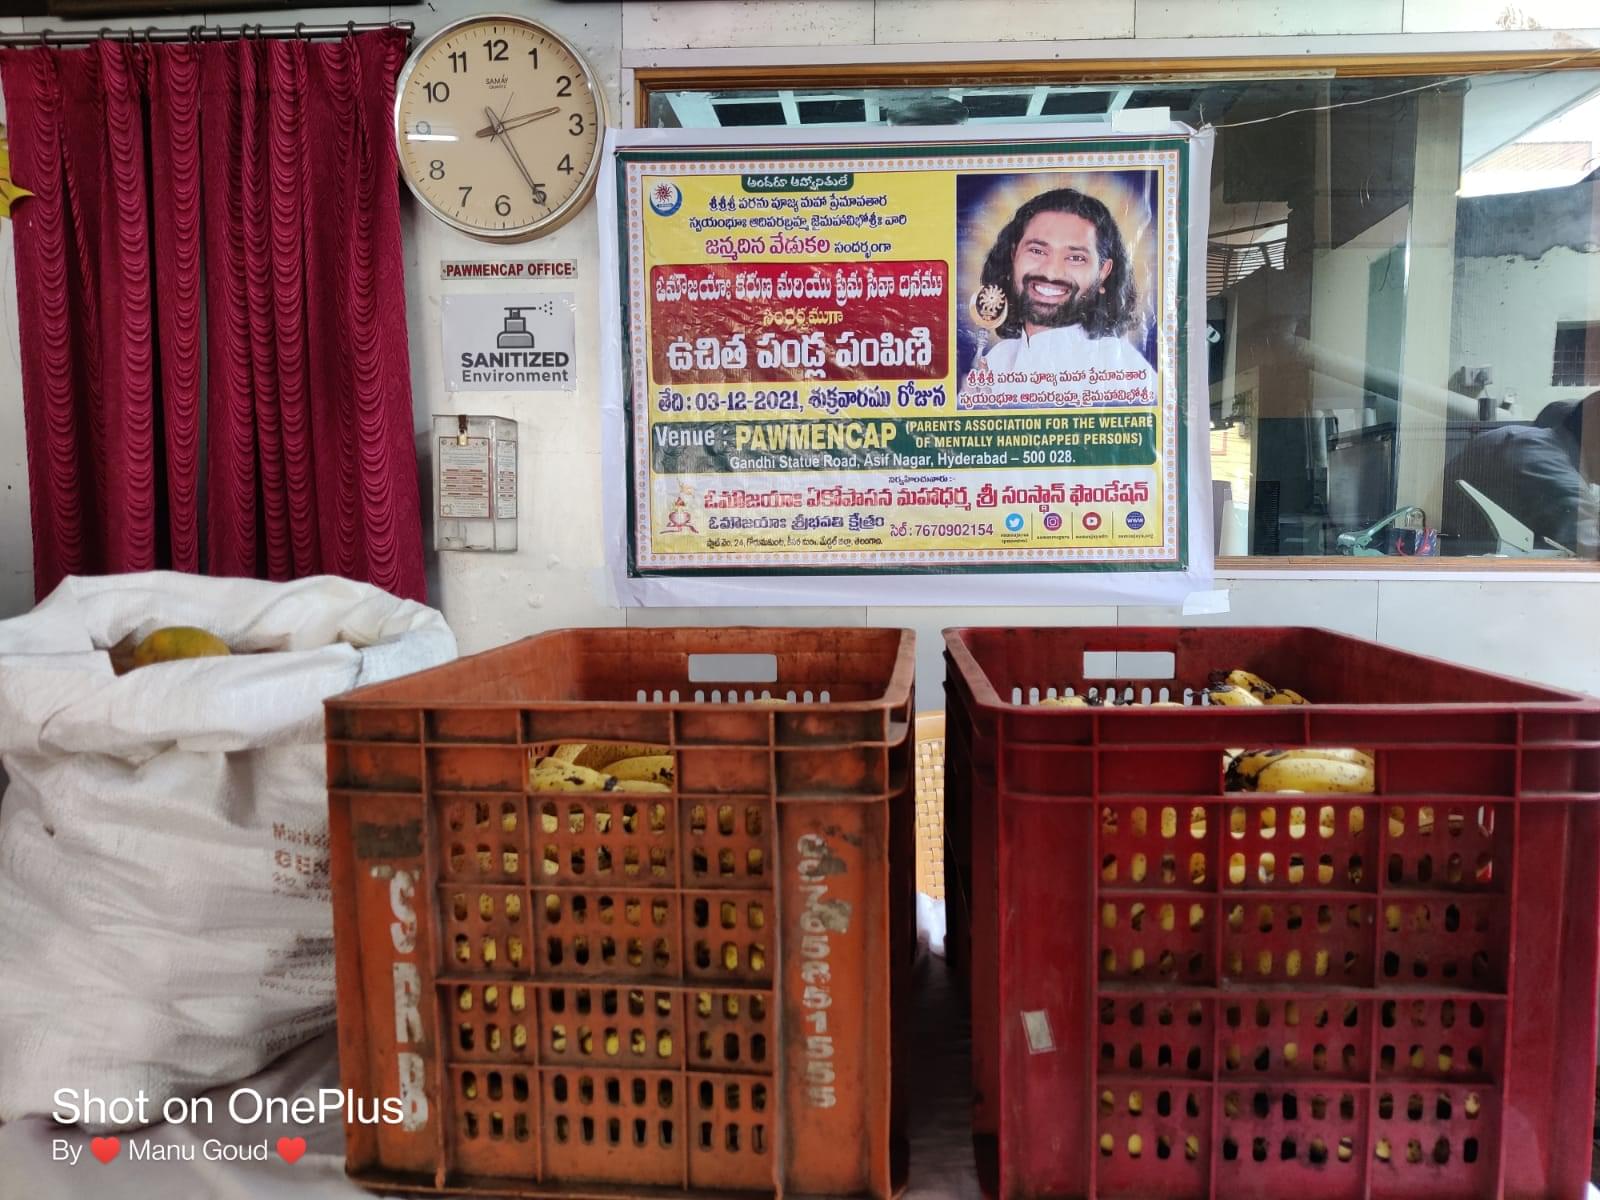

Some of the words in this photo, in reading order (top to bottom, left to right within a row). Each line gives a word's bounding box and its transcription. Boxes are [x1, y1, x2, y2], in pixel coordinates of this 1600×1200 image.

[483, 39, 509, 62] 12
[528, 48, 538, 70] 1
[448, 51, 467, 73] 11
[423, 81, 450, 103] 10
[556, 76, 572, 97] 2
[569, 113, 584, 136] 3
[429, 160, 446, 180] 8
[557, 154, 574, 175] 4
[458, 186, 472, 207] 7
[532, 183, 547, 205] 5
[495, 195, 511, 216] 6
[705, 235, 766, 261] జన్మదిన
[769, 232, 831, 255] వేడుకల
[446, 263, 524, 277] PAWMENCAP
[527, 263, 572, 276] OFFICE
[735, 270, 773, 300] కరుణ
[777, 270, 832, 300] మరియు
[461, 352, 569, 368] SANITIZED
[666, 332, 747, 370] ఉచిత
[757, 331, 827, 378] పండ్ల
[462, 369, 568, 383] Environment
[997, 370, 1028, 383] పరమ
[1059, 369, 1086, 382] మహా
[695, 390, 804, 413] 03-12-2021,
[897, 381, 946, 408] రోజున
[905, 419, 961, 434] (PARENTS
[965, 418, 1041, 432] ASSOCIATION
[1046, 417, 1068, 430] FOR
[1072, 416, 1095, 430] THE
[1098, 415, 1153, 430] WELFARE
[655, 426, 715, 447] Venue
[735, 422, 896, 451] PAWMENCAP
[915, 435, 931, 448] OF
[934, 434, 994, 448] MENTALLY
[996, 433, 1079, 447] HANDICAPPED
[1083, 431, 1142, 446] PERSONS)
[729, 455, 775, 470] Gandhi
[778, 454, 820, 469] Statue
[823, 454, 860, 469] Road,
[864, 455, 889, 468] Asif
[893, 452, 934, 468] Nagar,
[938, 451, 1008, 467] Hyderabad
[1023, 451, 1047, 464] 500
[1050, 450, 1076, 464] 028.
[976, 483, 998, 508] శ్రీ
[1069, 480, 1149, 506] ఫౌండేషన్
[915, 523, 993, 537] 7670902154
